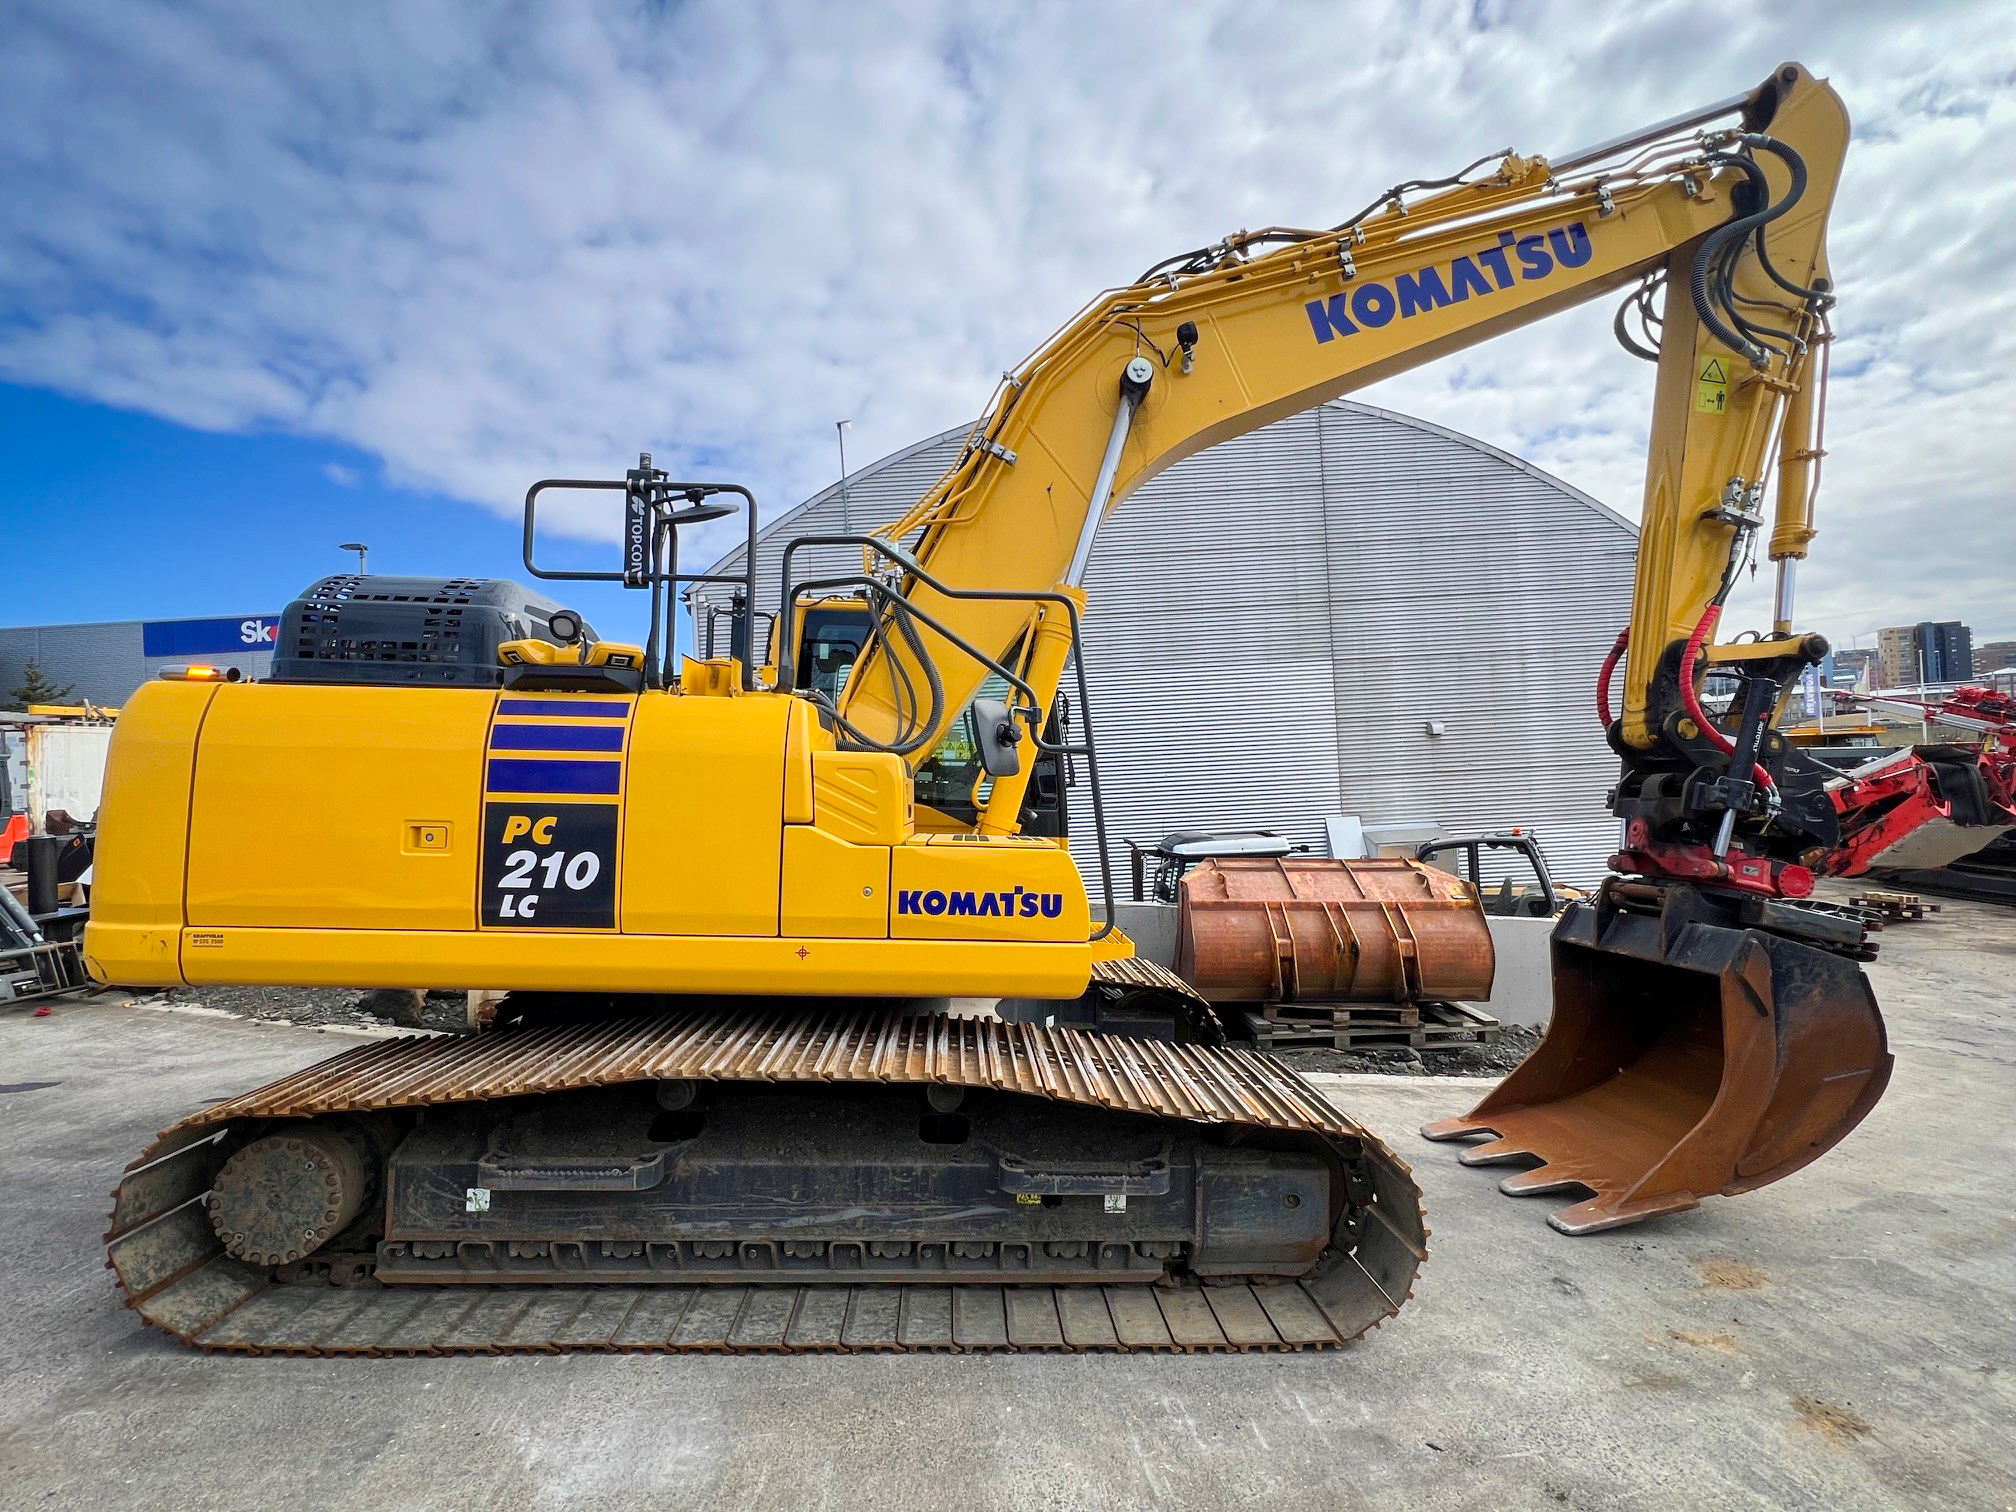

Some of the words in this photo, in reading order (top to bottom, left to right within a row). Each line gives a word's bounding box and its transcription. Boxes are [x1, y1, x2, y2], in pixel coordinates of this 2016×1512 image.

[1304, 221, 1593, 345] KOMATSU
[631, 516, 643, 573] TOPCON
[501, 815, 558, 845] PC
[497, 849, 600, 890] 210
[499, 894, 539, 918] LC
[898, 885, 1063, 918] KOMATSU
